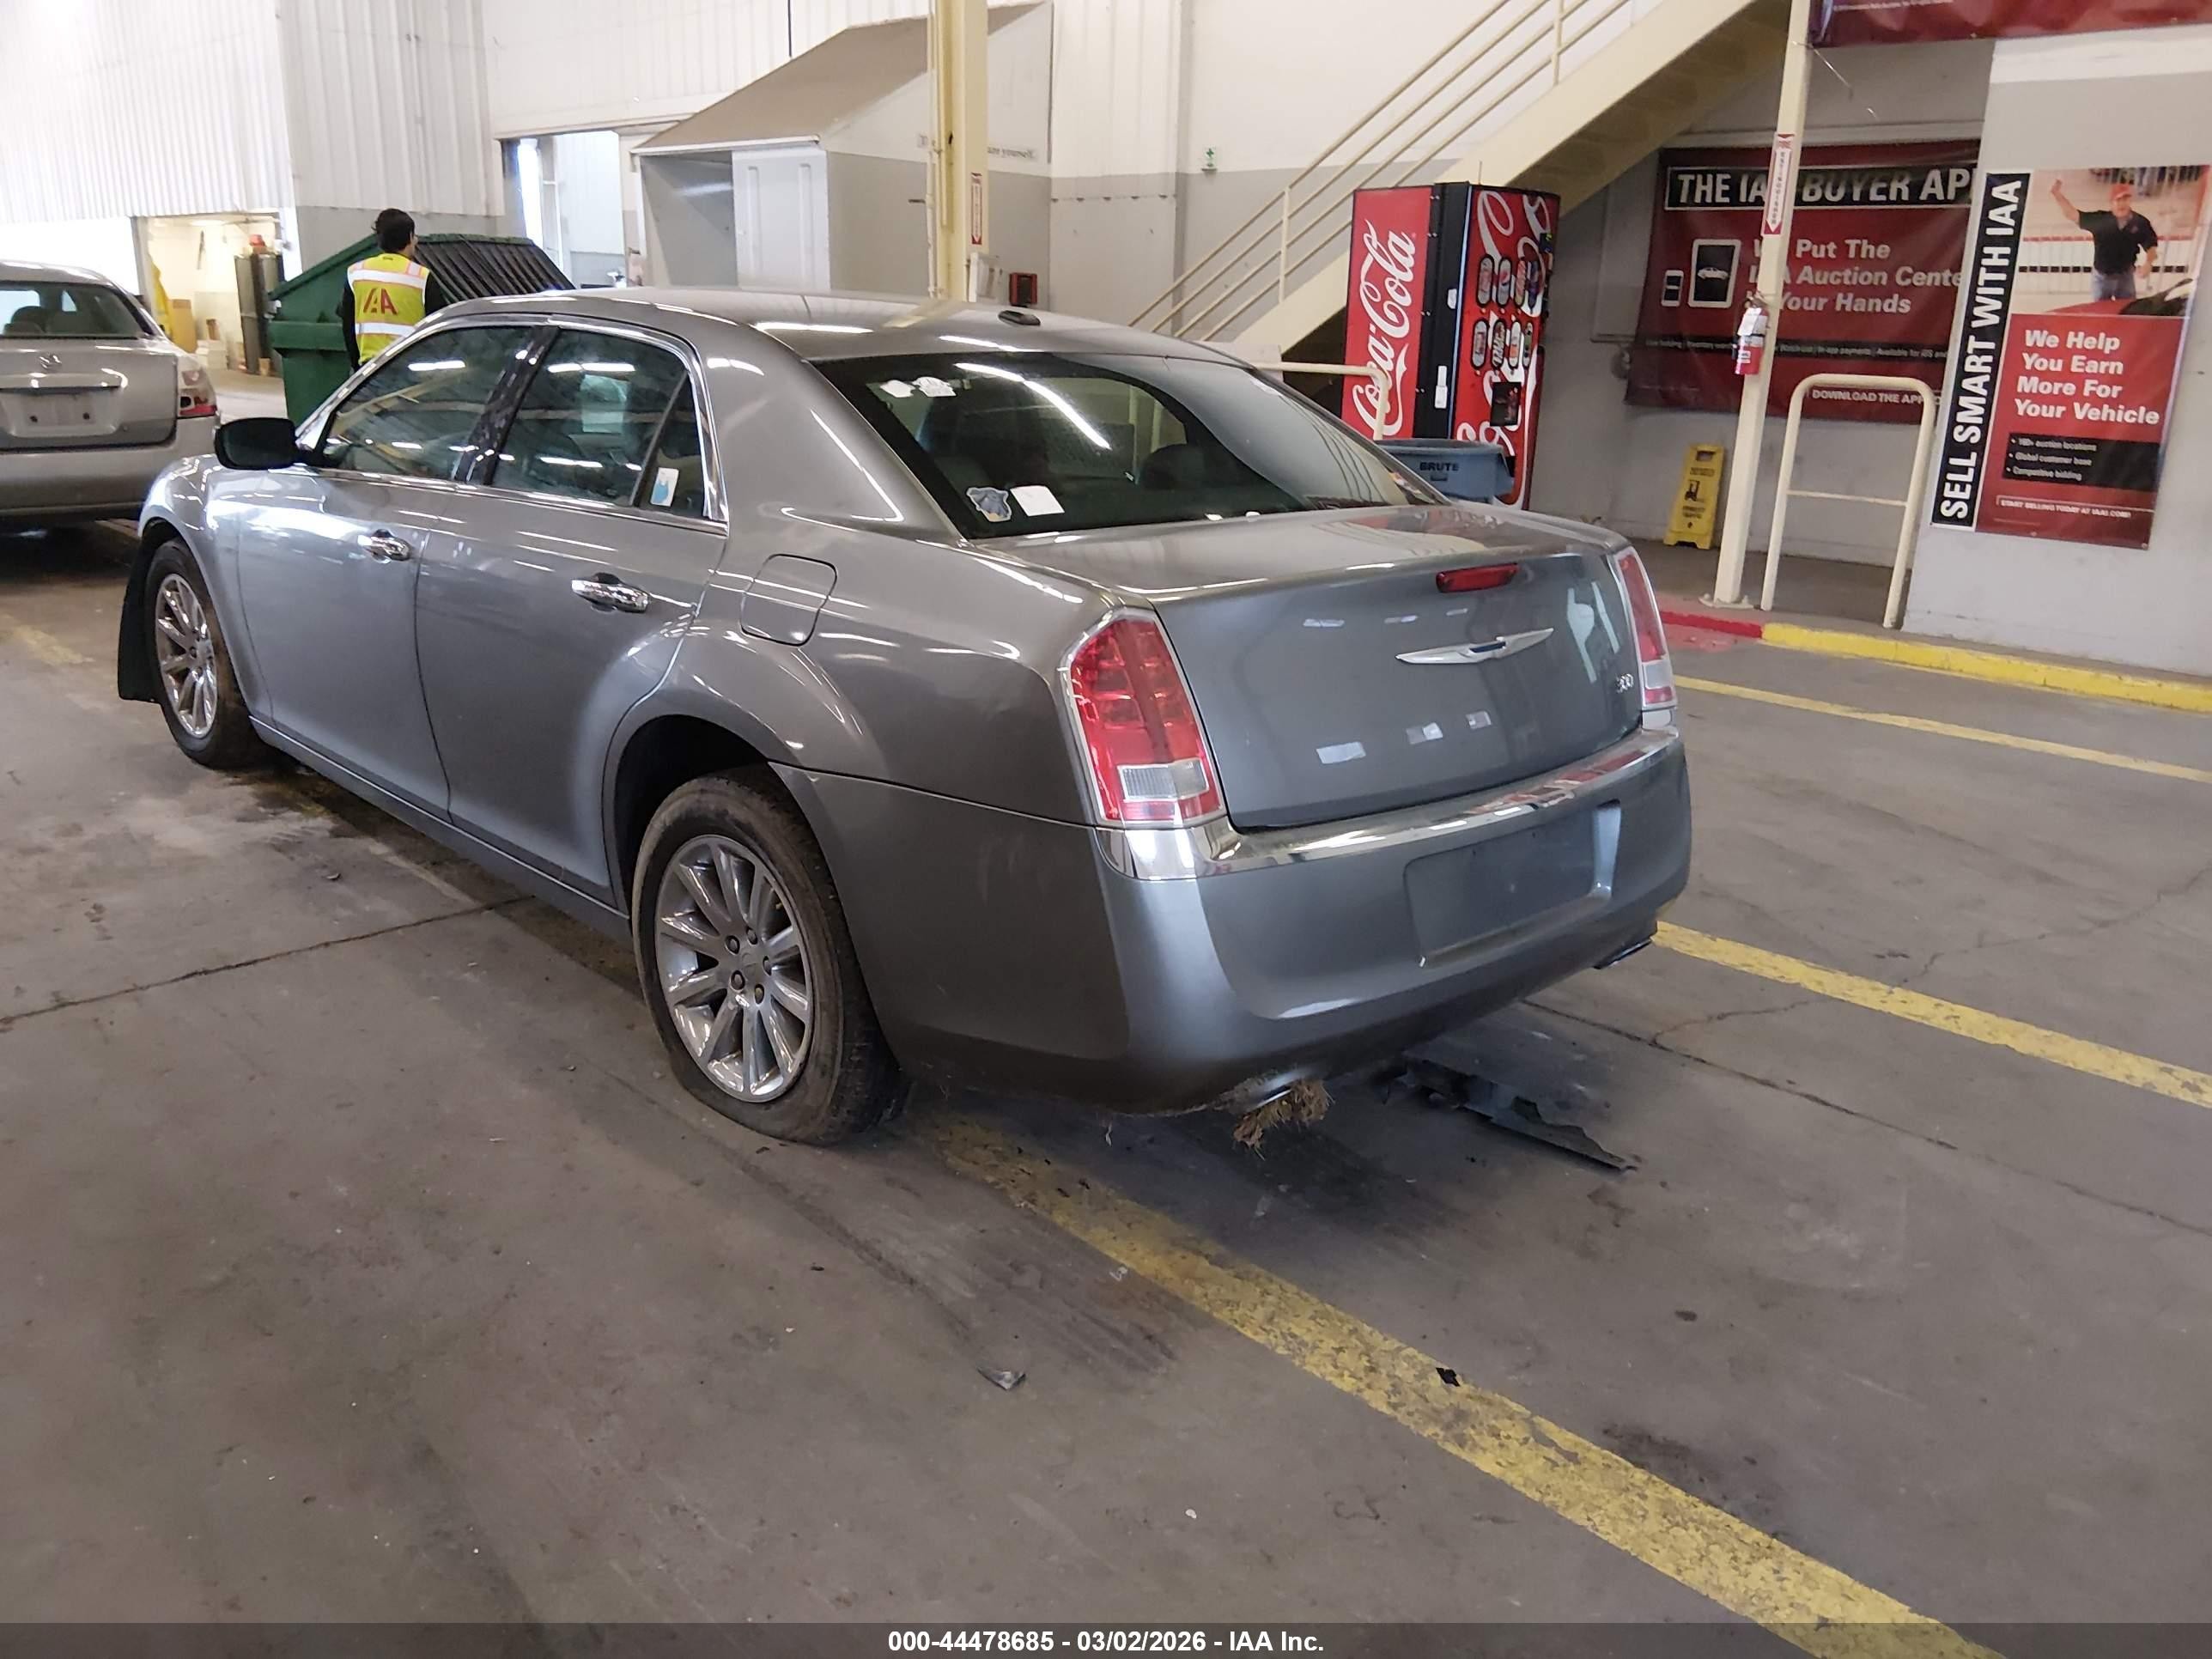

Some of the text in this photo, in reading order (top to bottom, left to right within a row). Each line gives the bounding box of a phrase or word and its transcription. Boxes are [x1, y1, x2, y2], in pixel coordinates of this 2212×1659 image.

[1677, 167, 1975, 204] THE IA BUYER AP
[1796, 239, 1891, 258] Put The
[1796, 265, 1888, 285] Auction
[1835, 293, 1911, 313] Hands
[1940, 180, 2021, 519] SELL SMART WITH IAA
[2025, 330, 2121, 354] We Help
[2021, 352, 2124, 374] You Earn
[1812, 390, 1878, 403] DOWNLOAD
[1879, 392, 1899, 404] THE
[2017, 375, 2123, 398] More For
[2014, 398, 2160, 425] Your Vehicle
[1419, 462, 1460, 471] BRUTE
